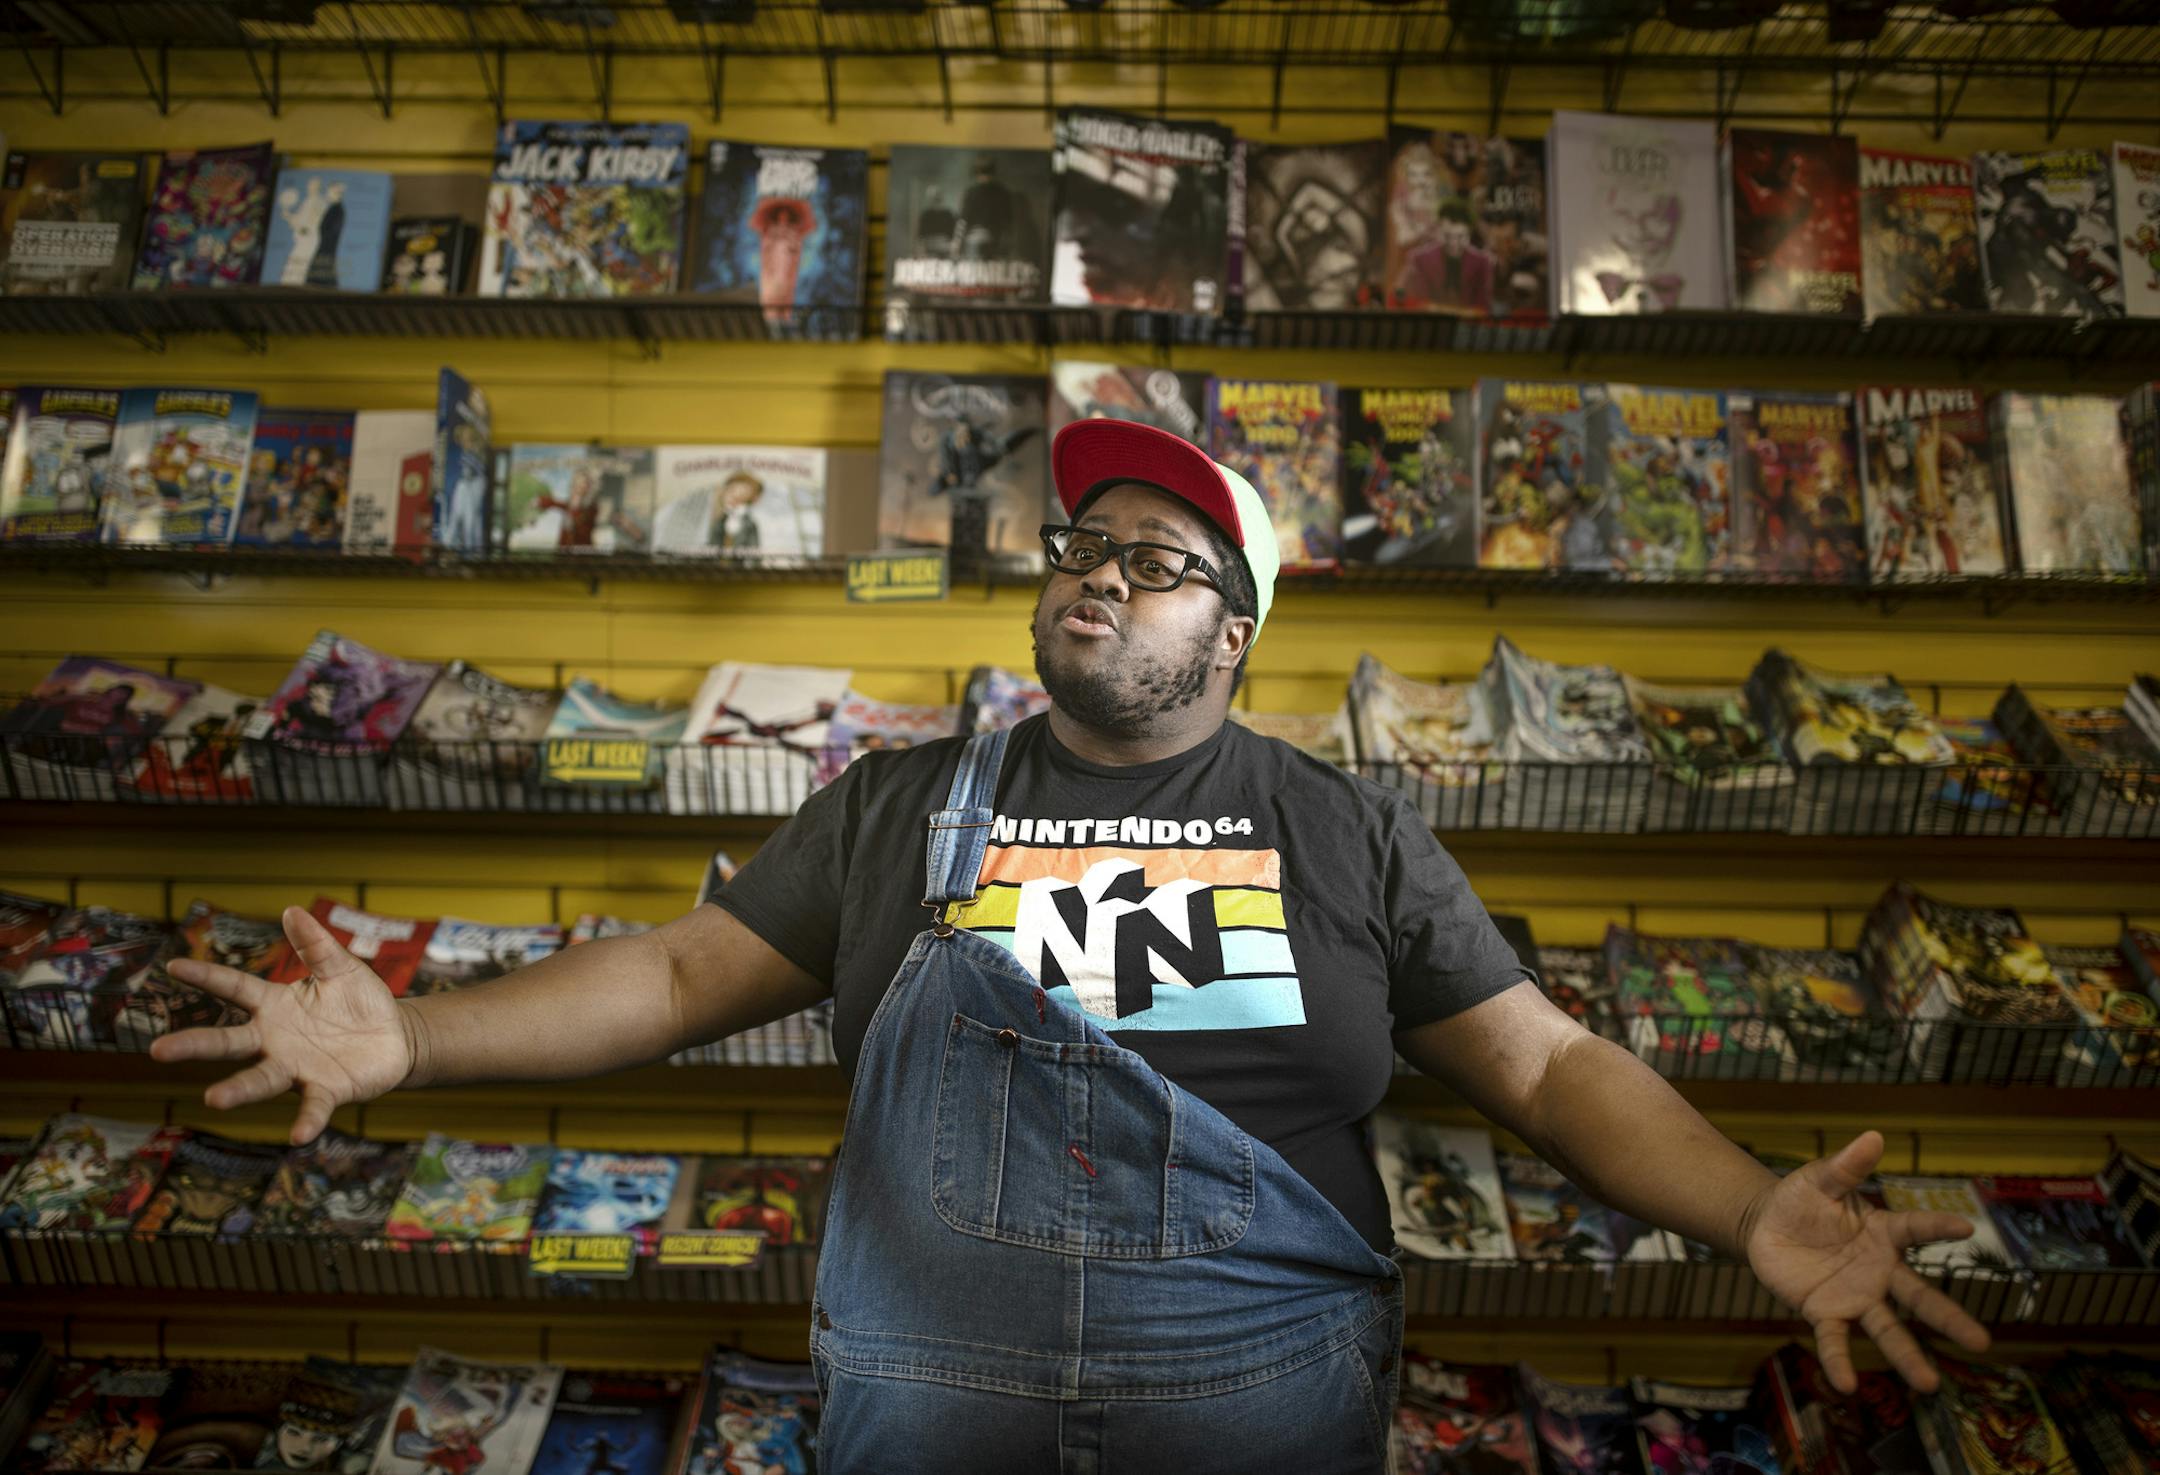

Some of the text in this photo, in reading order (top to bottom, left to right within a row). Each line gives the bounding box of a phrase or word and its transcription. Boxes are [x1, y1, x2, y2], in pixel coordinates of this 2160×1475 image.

[498, 145, 582, 180] JACK
[587, 145, 679, 181] KIRBY
[1861, 155, 1973, 188] MARVEL
[1219, 382, 1322, 411] MARVEL
[1361, 388, 1453, 414] MARVEL
[1504, 382, 1580, 403] MARVEL
[1622, 391, 1718, 426] MARVEL
[1760, 402, 1849, 430] MARVEL
[848, 559, 889, 586] LAST
[548, 740, 592, 768] LAST
[991, 815, 1253, 845] NINTENDO 64
[530, 1236, 574, 1261] LAST
